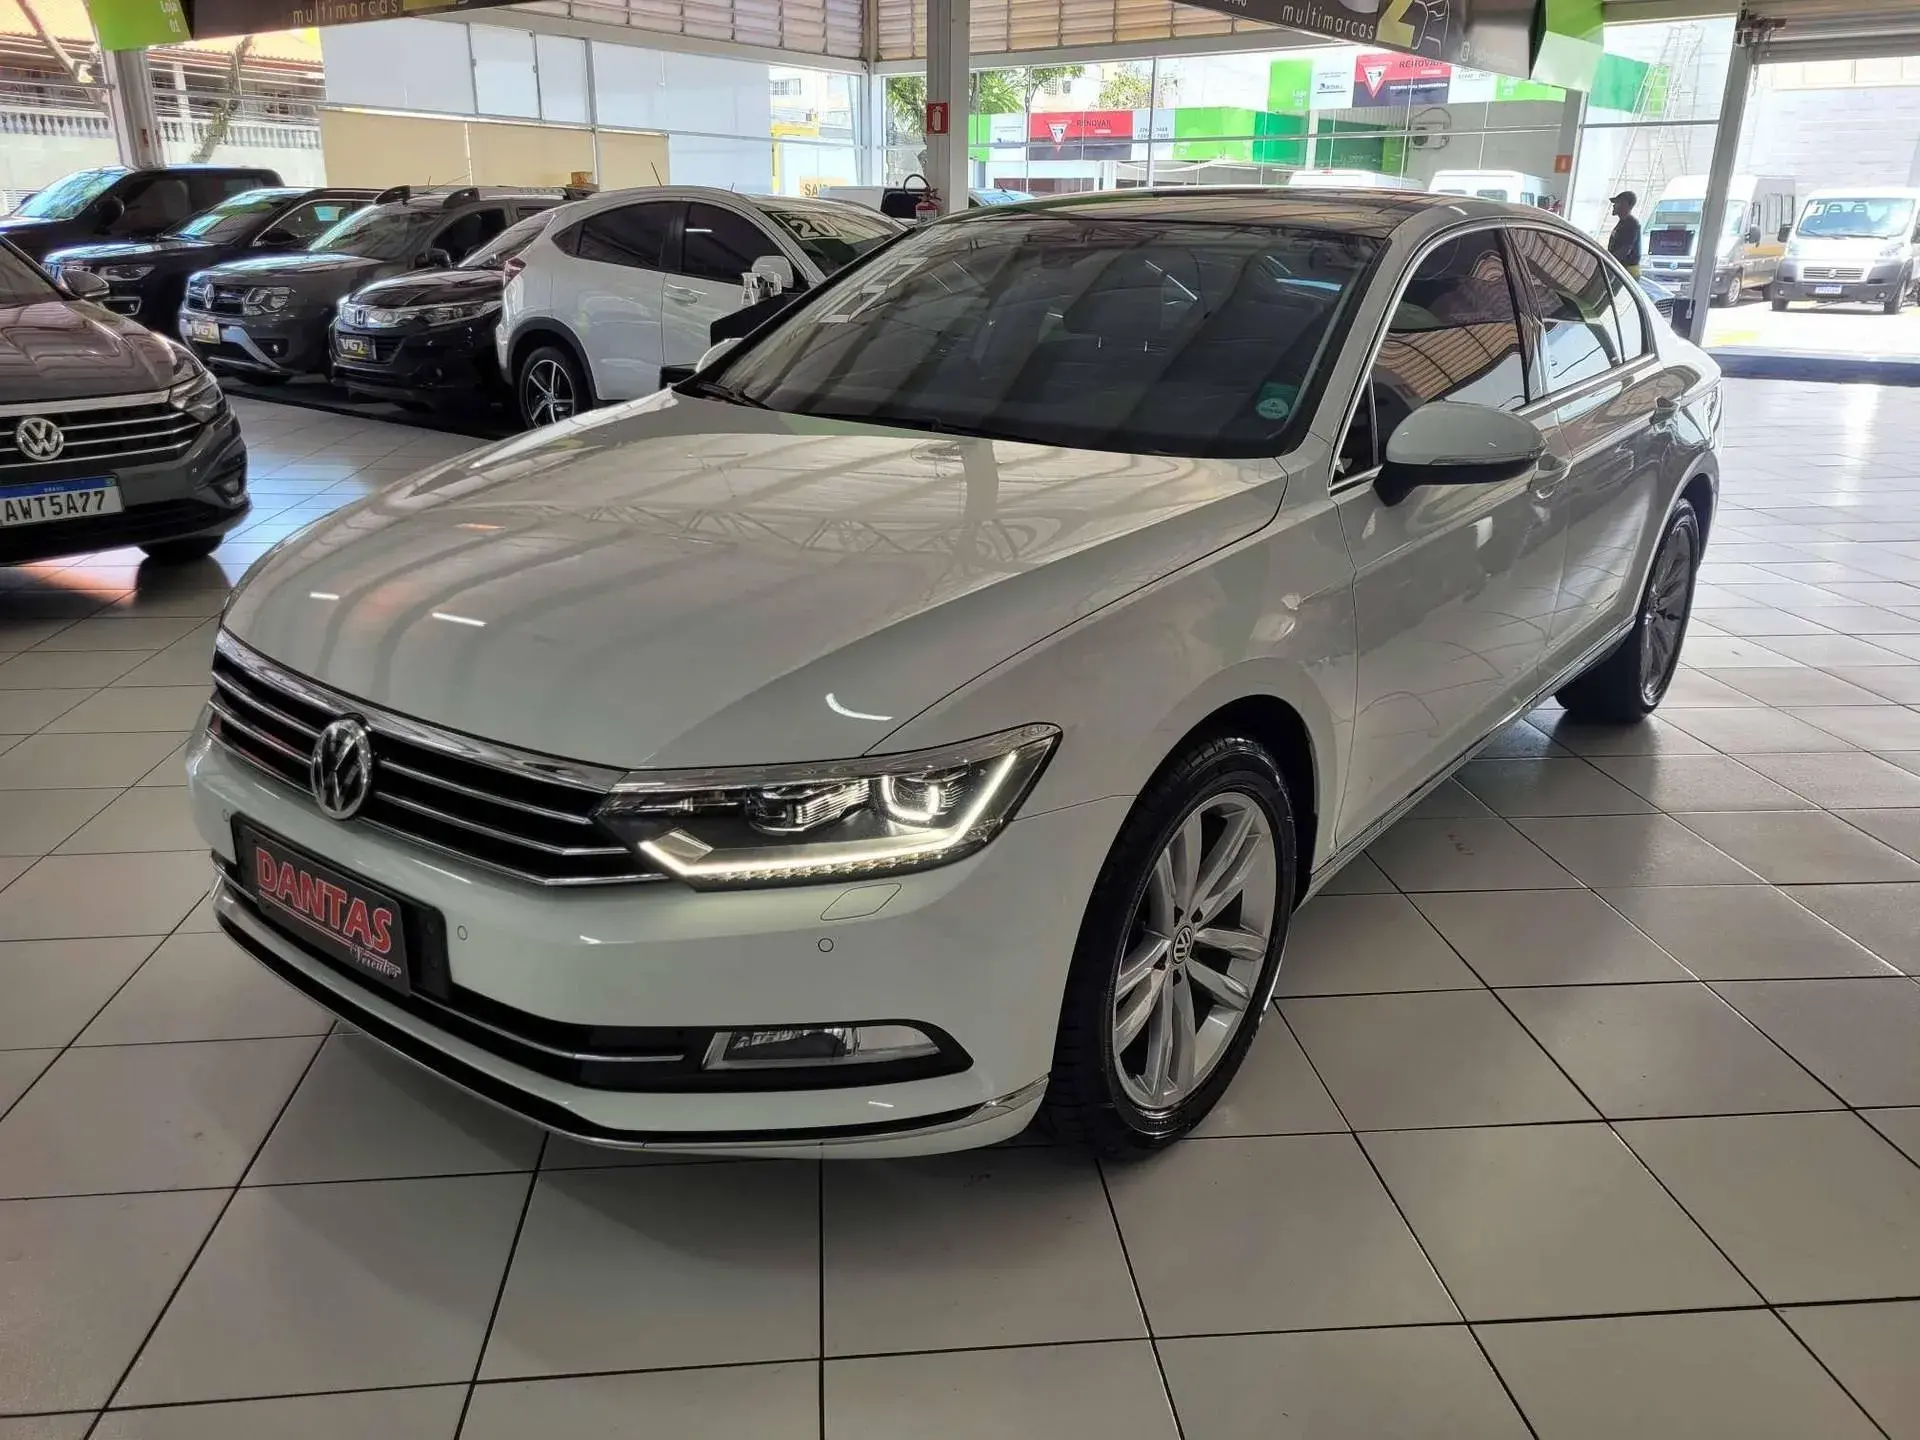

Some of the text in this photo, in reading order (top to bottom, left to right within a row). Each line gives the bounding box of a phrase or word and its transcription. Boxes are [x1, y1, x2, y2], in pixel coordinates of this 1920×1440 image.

[292, 0, 398, 24] multimarcas
[1281, 2, 1375, 40] multimarcas
[340, 338, 367, 355] VG2
[4, 489, 105, 521] AWT5A77
[256, 846, 392, 954] DANTAS
